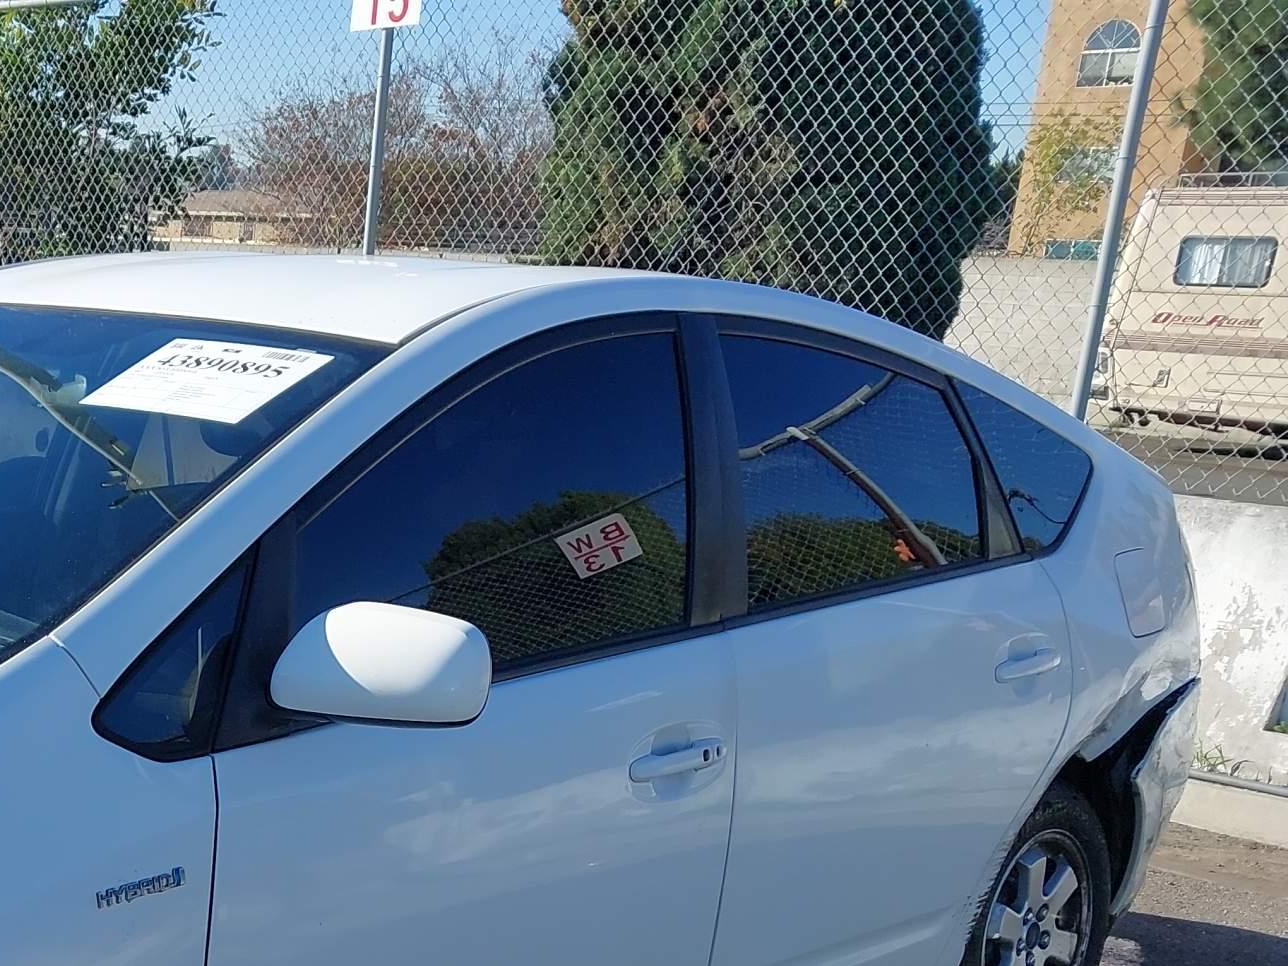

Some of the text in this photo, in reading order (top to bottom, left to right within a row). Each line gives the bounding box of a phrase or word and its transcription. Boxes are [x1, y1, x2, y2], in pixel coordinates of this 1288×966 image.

[1152, 311, 1205, 327] Open
[158, 354, 291, 379] 43890895
[95, 866, 185, 909] HYBRID
